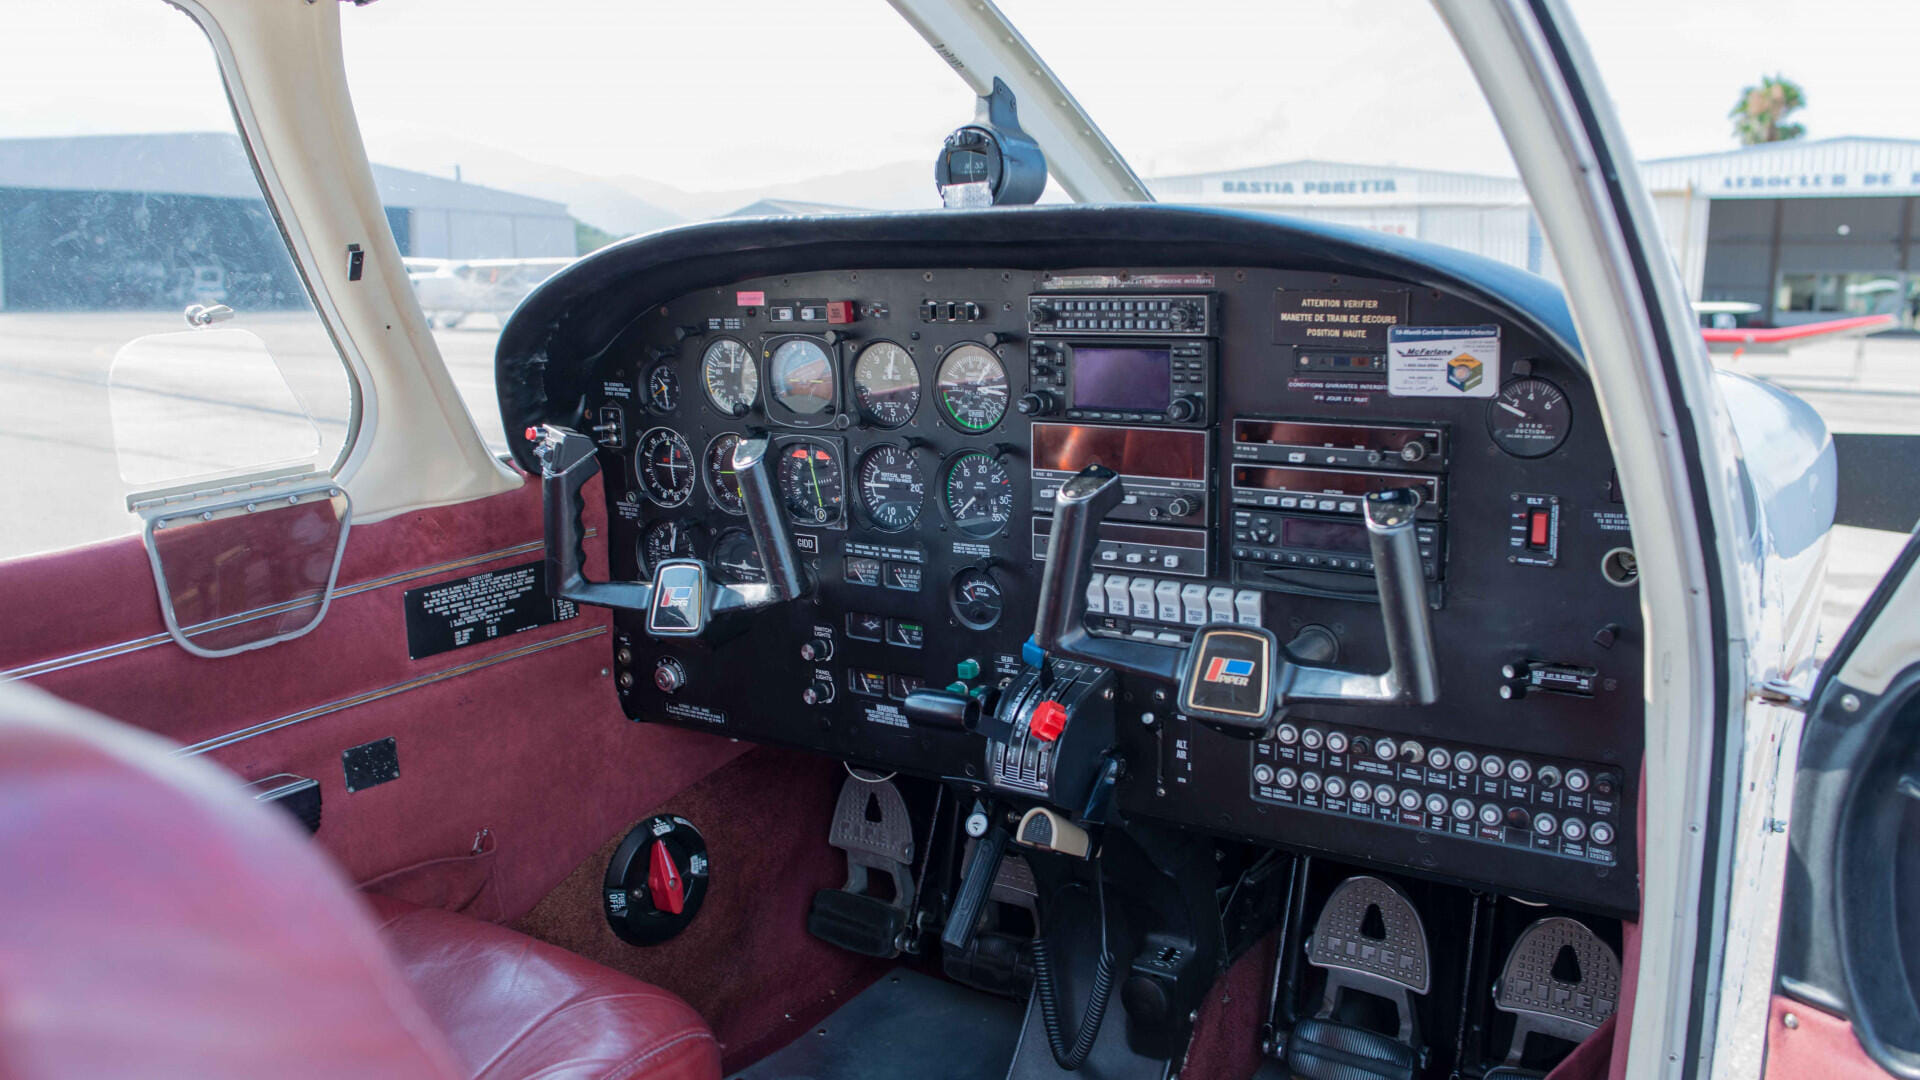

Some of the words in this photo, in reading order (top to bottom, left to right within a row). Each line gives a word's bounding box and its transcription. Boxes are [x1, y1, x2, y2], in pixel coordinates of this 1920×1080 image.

[1222, 181, 1295, 194] BASTIA
[1301, 298, 1341, 309] ATTENTION
[1343, 299, 1379, 310] VERIFIER
[1280, 312, 1313, 323] MANETTE
[1314, 313, 1325, 323] DE
[1326, 313, 1348, 323] TRAIN
[1349, 314, 1361, 324] DE
[1361, 315, 1397, 325] SECOURS
[1306, 328, 1341, 338] POSITION
[1342, 329, 1368, 339] HAUTE
[1407, 347, 1454, 356] McFarlane
[1527, 392, 1535, 401] 4
[1511, 398, 1520, 408] 2
[1544, 401, 1553, 411] 6
[889, 407, 897, 418] 5
[886, 455, 896, 466] 10
[963, 467, 971, 477] 15
[977, 464, 988, 475] 20
[991, 473, 1001, 484] 25
[910, 483, 921, 493] 20
[956, 479, 964, 490] 10
[958, 498, 964, 508] 5
[999, 495, 1009, 505] 30
[1526, 497, 1544, 505] ELT
[887, 506, 897, 516] 10
[991, 512, 1002, 522] 35
[1291, 555, 1297, 563] 3
[815, 668, 831, 677] PANEL
[815, 674, 833, 683] LIGHTS
[1175, 749, 1187, 760] AIR
[1327, 936, 1415, 970] PIPER
[1515, 978, 1616, 1016] PIPER
